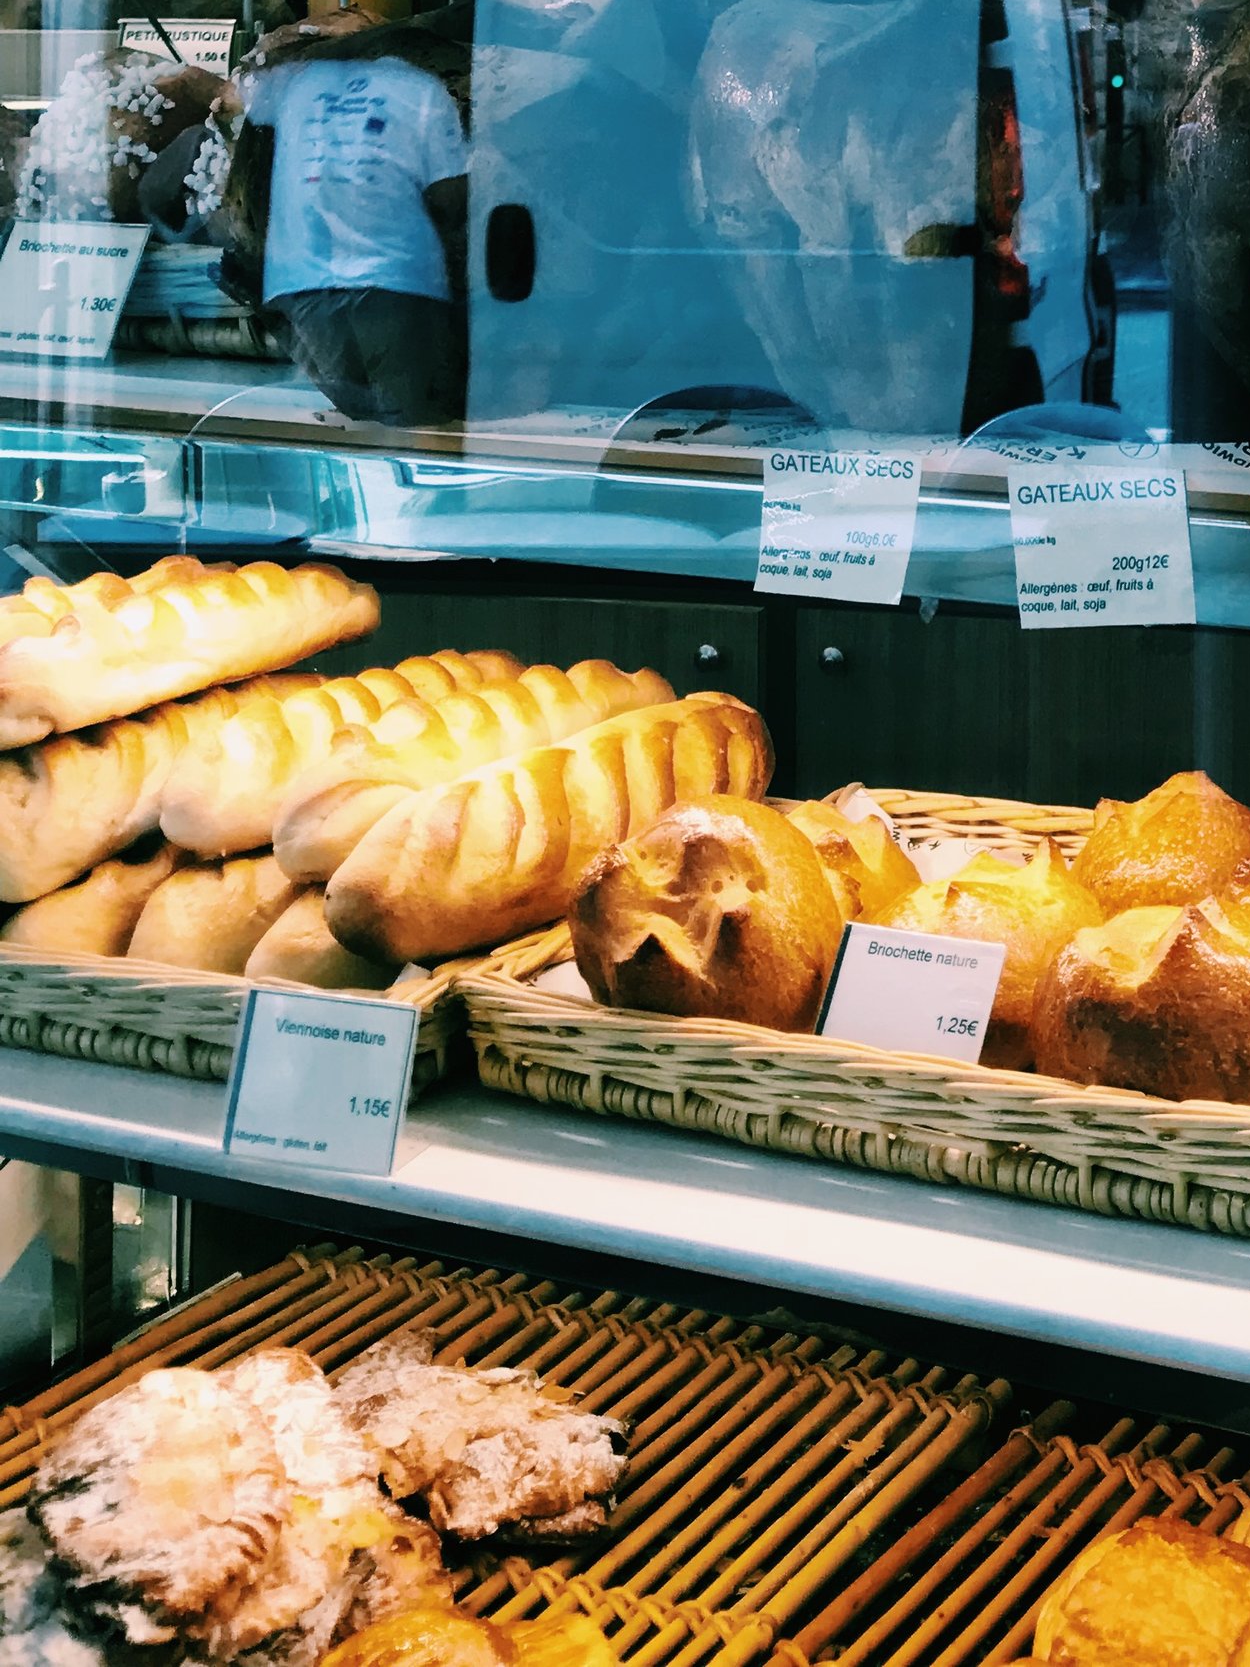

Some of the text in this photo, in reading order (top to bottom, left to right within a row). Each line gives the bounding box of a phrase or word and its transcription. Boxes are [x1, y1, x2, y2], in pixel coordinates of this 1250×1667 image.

[219, 52, 227, 62] €
[20, 239, 129, 258] Briochette au sucre
[770, 453, 914, 479] GATEAUX SECS
[1017, 477, 1177, 505] GATEAUX SECS
[819, 551, 841, 565] œuf,
[843, 551, 867, 565] fruits
[868, 555, 876, 566] à
[1112, 554, 1170, 573] 200g12€
[759, 564, 832, 581] coque, lait, soja
[1019, 578, 1154, 597] Allergènes œuf, fruits à
[1020, 598, 1107, 614] coque, lait, soja
[868, 941, 978, 969] Briochette nature
[275, 1018, 387, 1046] Viennoise nature
[936, 1016, 979, 1037] 1,25€
[349, 1096, 392, 1119] 1,15€
